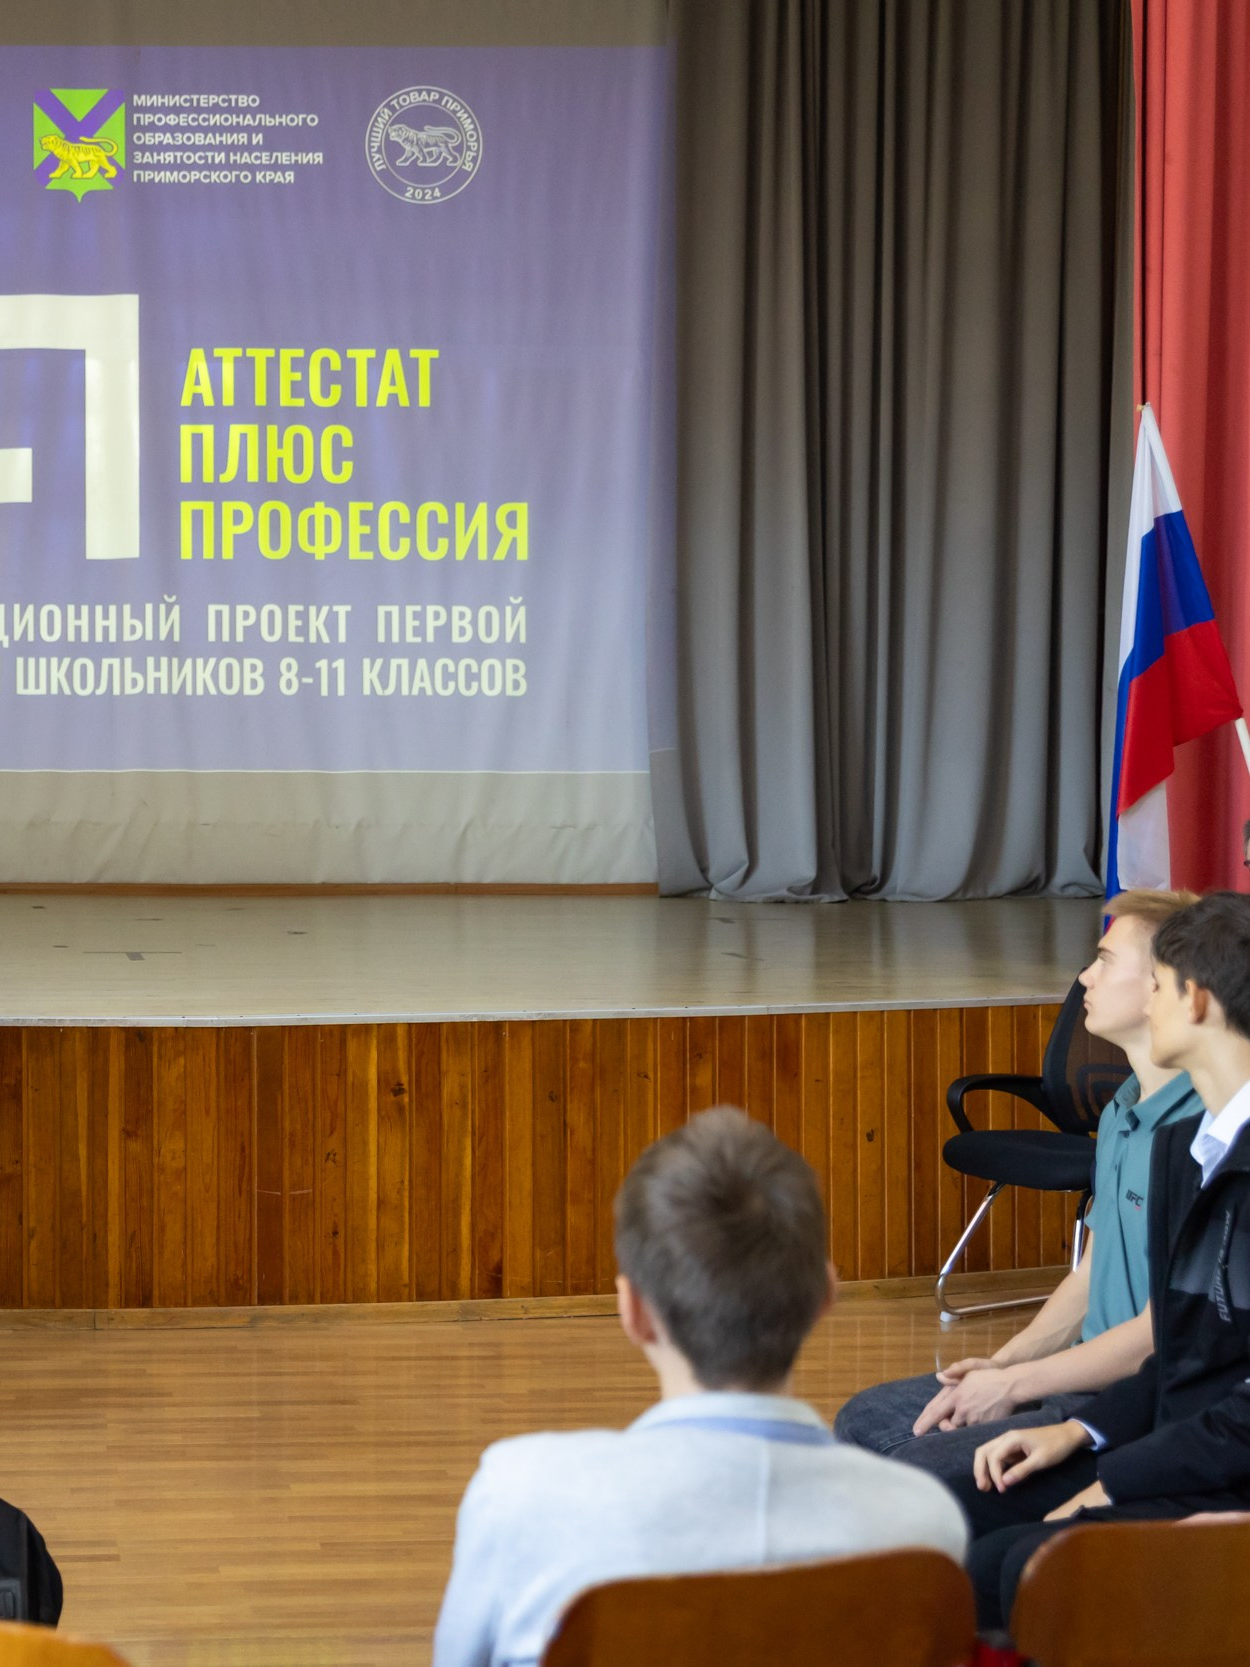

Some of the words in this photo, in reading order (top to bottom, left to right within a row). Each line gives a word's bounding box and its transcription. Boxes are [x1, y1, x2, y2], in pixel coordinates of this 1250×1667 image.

[133, 94, 260, 108] МИНИСТЕРСТВО
[133, 113, 319, 127] ПРОФЕССИОНАЛЬНОГО
[370, 107, 393, 172] ЛУЧШИЙ
[390, 90, 440, 110] ТОВАР
[441, 95, 478, 172] ПРИМОРЬЯ
[133, 132, 248, 146] ОБРАЗОВАНИЯ
[252, 133, 263, 146] И
[133, 151, 226, 165] ЗАНЯТОСТИ
[229, 151, 324, 165] НАСЕЛЕНИЯ
[133, 170, 252, 184] ПРИМОРСКОГО
[256, 170, 295, 184] КРАЯ
[404, 186, 441, 200] 2024
[180, 348, 440, 407] АТТЕСТАТ
[180, 424, 354, 484] ПЛЮС
[180, 500, 529, 561] ПРОФЕССИЯ
[207, 603, 352, 644] ПРОЕКТ
[376, 596, 527, 644] ПЕРВОЙ
[16, 656, 265, 696] ШКОЛЬНИКОВ
[279, 657, 346, 696] 8-11
[362, 657, 528, 696] КЛАССОВ
